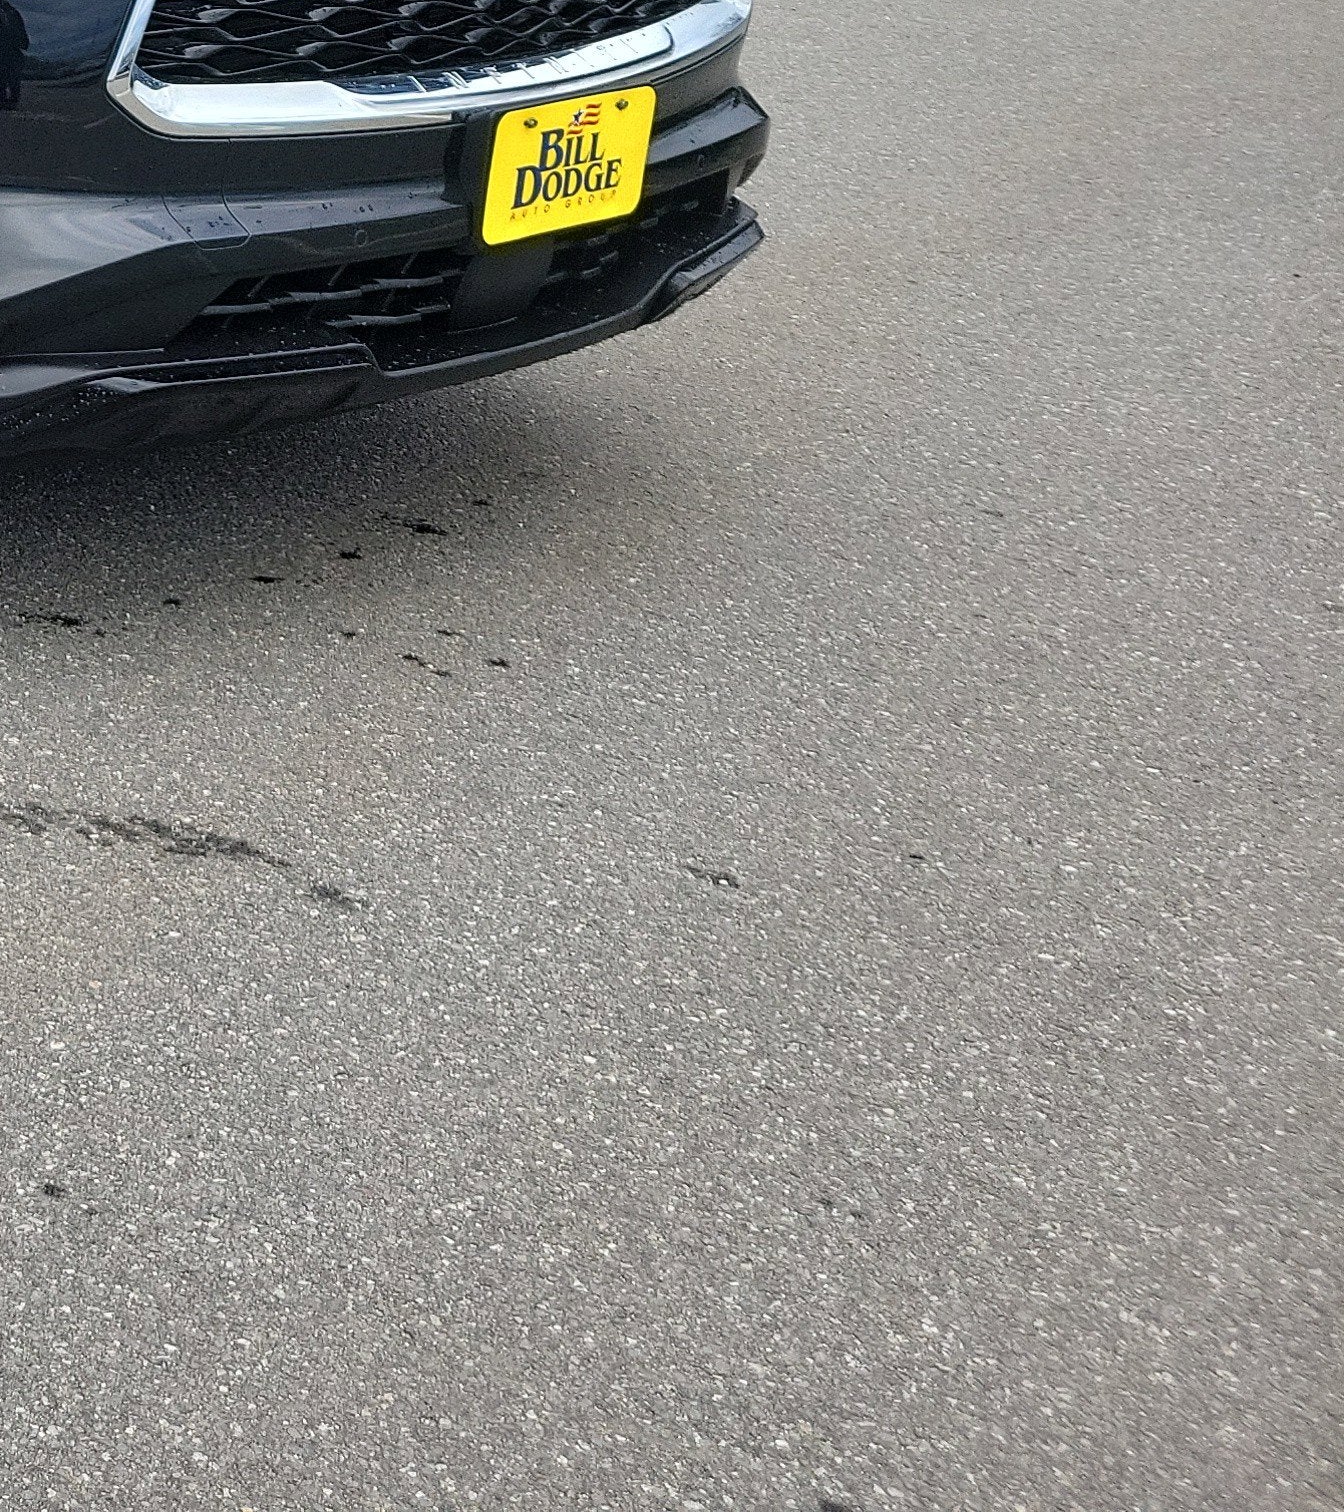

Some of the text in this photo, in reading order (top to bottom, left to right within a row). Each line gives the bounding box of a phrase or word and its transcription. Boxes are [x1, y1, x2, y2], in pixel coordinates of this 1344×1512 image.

[539, 128, 606, 172] BILL
[509, 189, 617, 221] AUTO GROUP
[510, 158, 623, 210] DODGE
